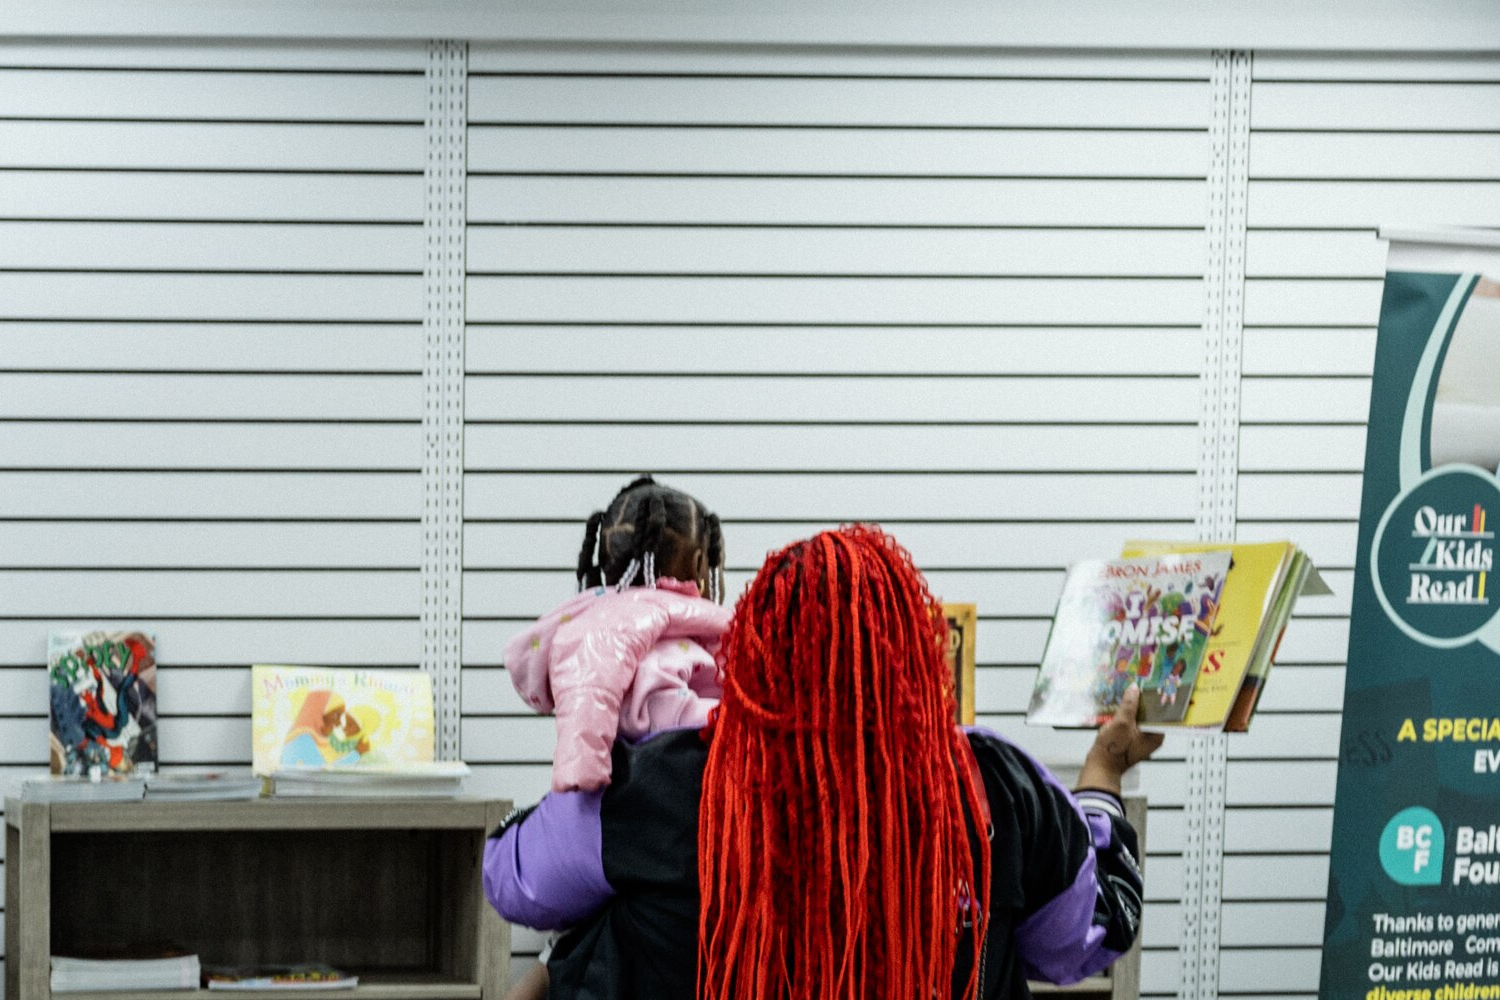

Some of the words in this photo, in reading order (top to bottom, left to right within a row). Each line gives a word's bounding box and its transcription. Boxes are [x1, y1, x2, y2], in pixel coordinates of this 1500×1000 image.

[1414, 505, 1467, 536] Our
[1436, 539, 1493, 571] Kids
[1410, 573, 1474, 602] Read
[1103, 615, 1198, 648] OMISE
[1396, 718, 1418, 742] A
[1372, 912, 1434, 934] Thanks
[1438, 913, 1454, 932] to
[1370, 937, 1454, 958] Baltimore
[1368, 962, 1404, 982] Our
[1406, 960, 1441, 981] Kids
[1444, 957, 1484, 979] Read
[1487, 956, 1499, 977] is
